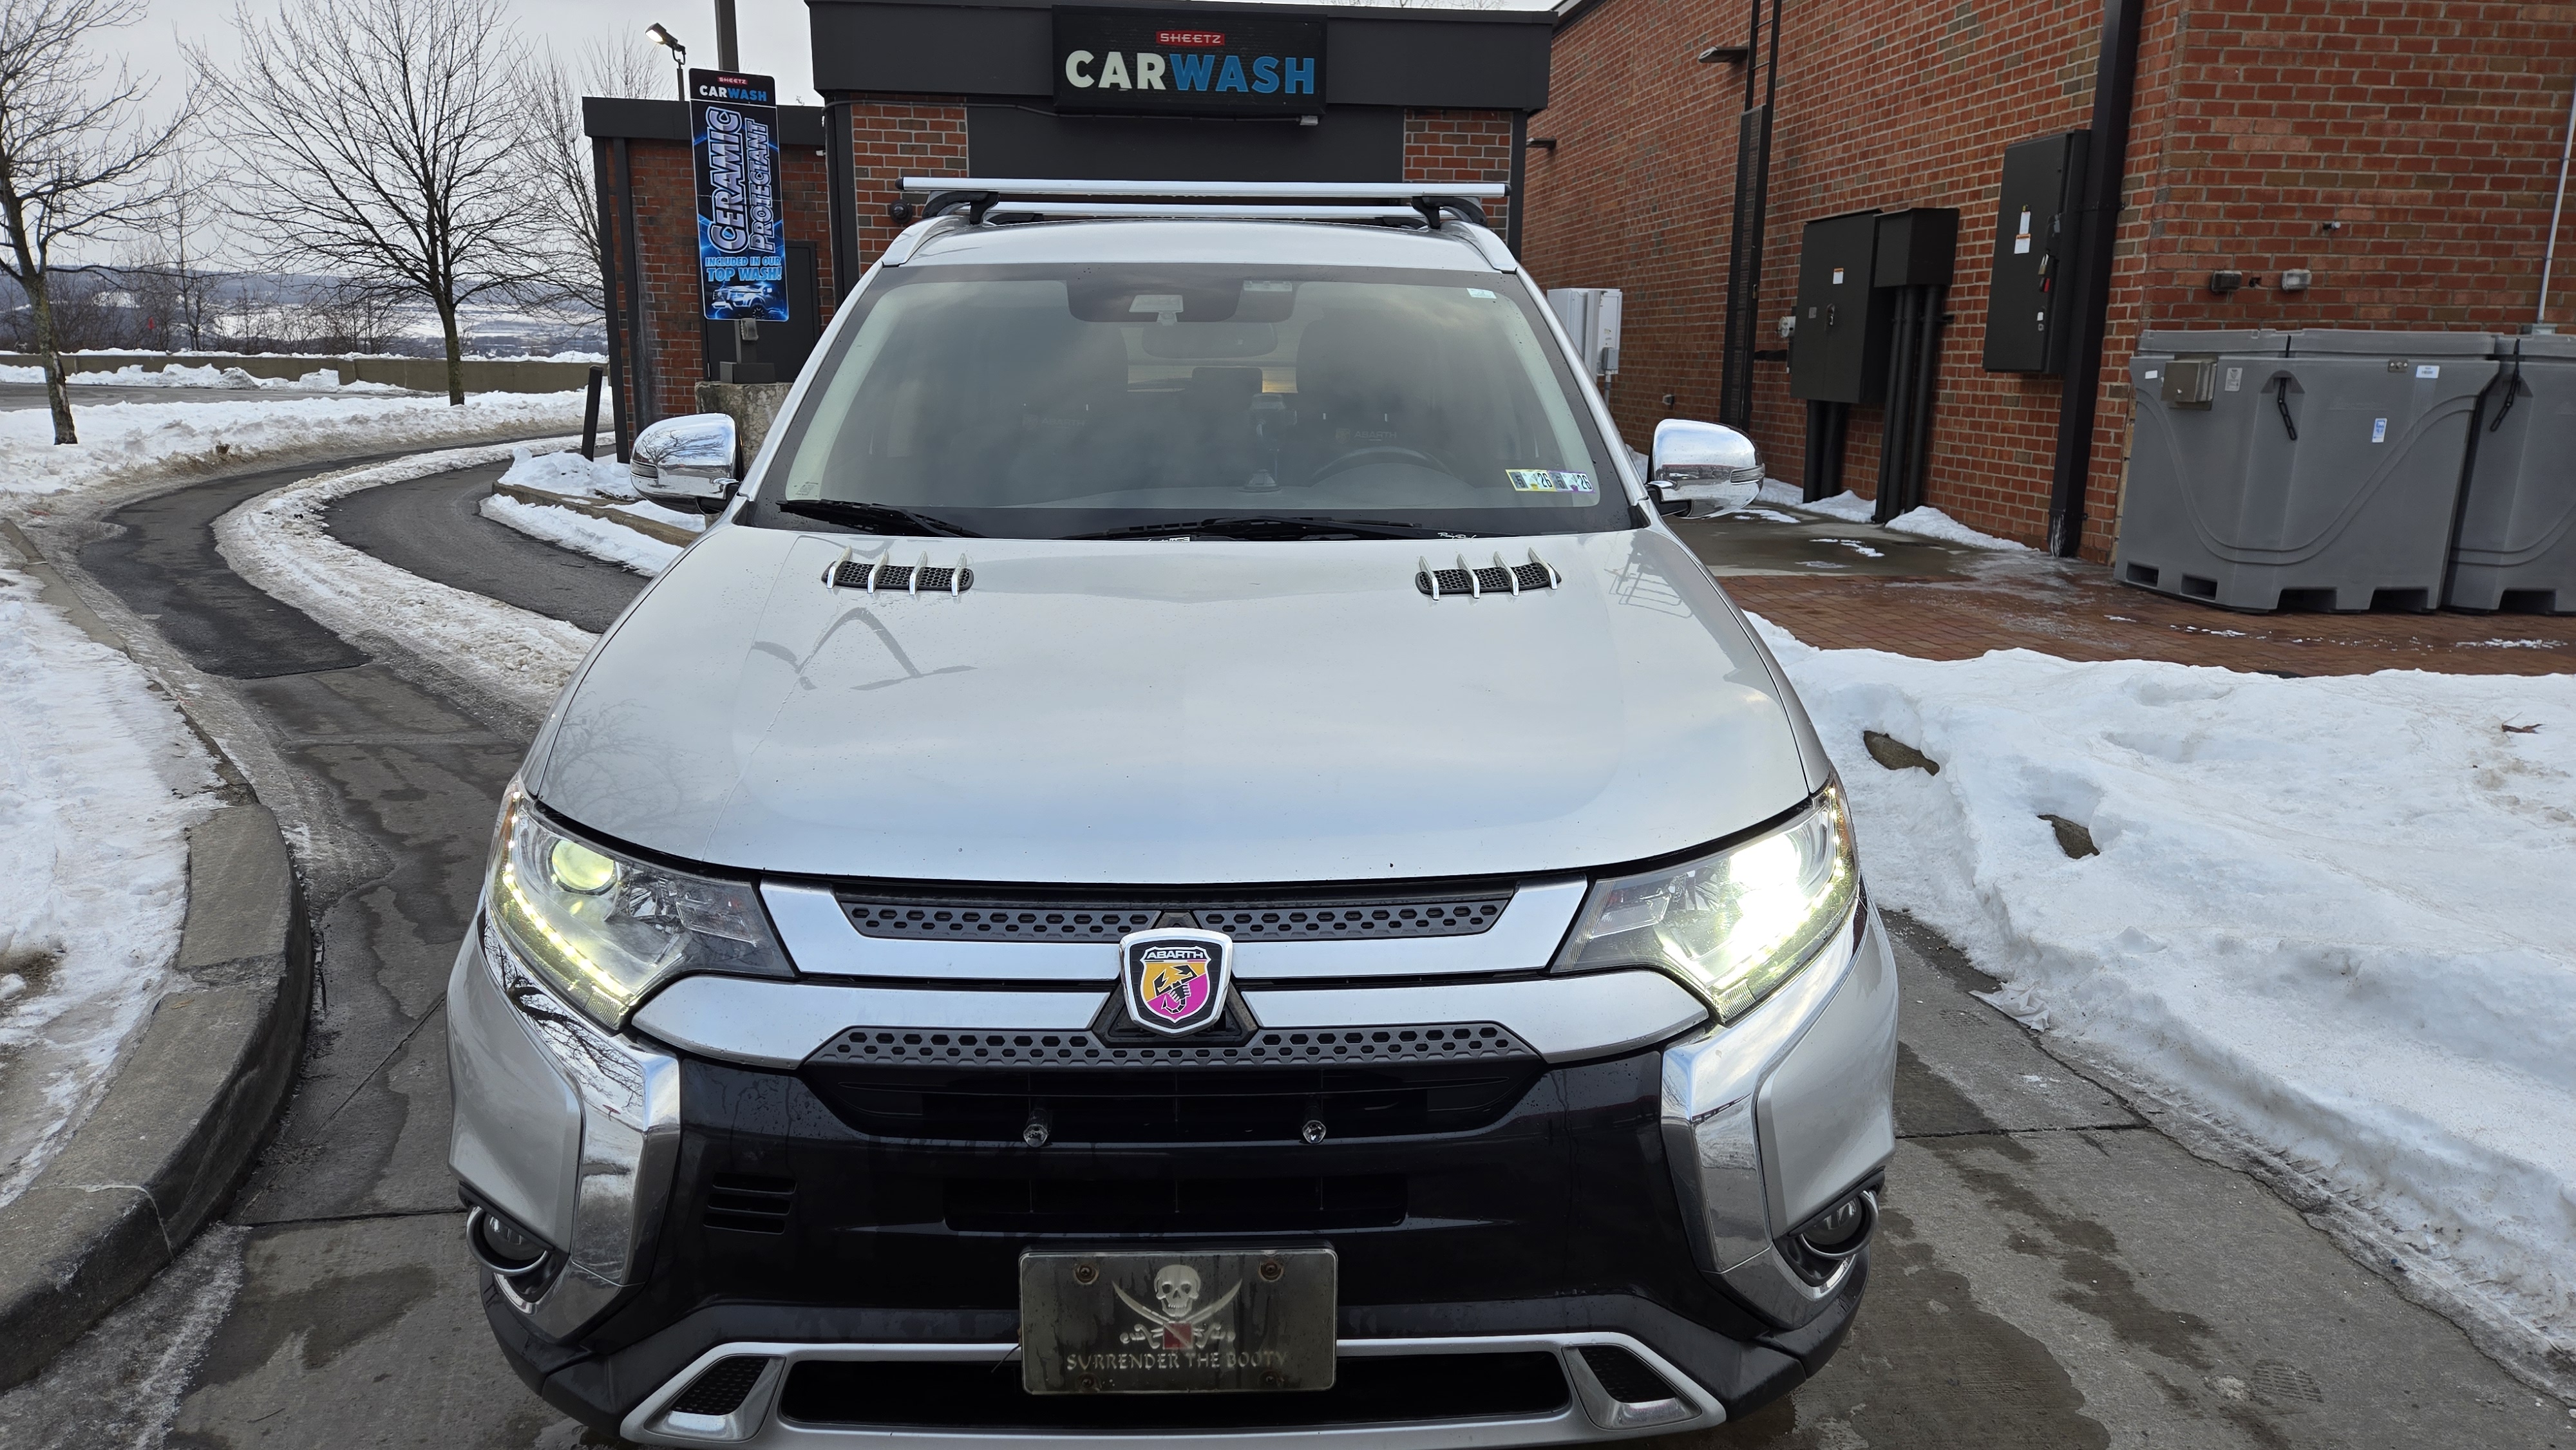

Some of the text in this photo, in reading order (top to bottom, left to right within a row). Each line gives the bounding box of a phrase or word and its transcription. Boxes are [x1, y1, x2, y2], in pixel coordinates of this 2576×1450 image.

[1159, 33, 1222, 44] SHEETZ
[706, 106, 748, 253] CERAMIC
[745, 118, 776, 253] PROTECTANT
[705, 256, 781, 267] INCLUDED IN OUR
[706, 267, 782, 281] TOP WASH!
[1537, 473, 1553, 488] 26
[1577, 475, 1593, 490] 26
[1146, 950, 1203, 959] ABARTH
[1066, 1350, 1289, 1370] SURRENDER THE BOOTY
